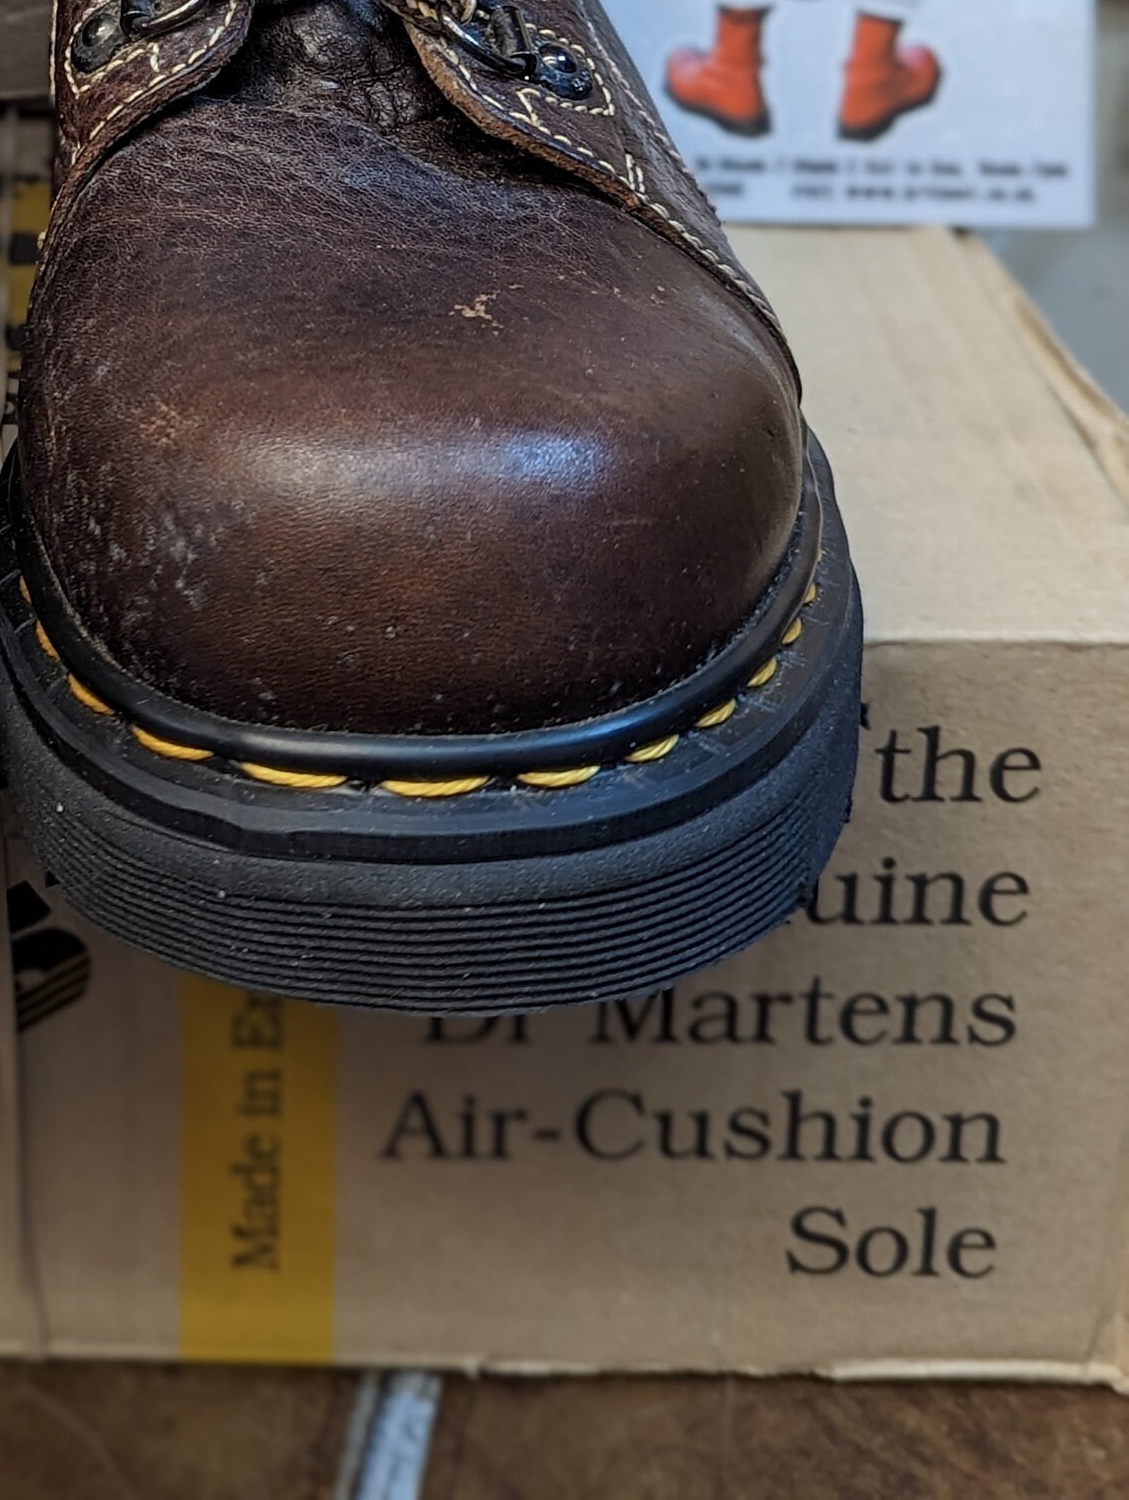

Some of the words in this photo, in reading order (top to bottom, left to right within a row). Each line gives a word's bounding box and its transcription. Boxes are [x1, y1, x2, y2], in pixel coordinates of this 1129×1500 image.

[874, 725, 1042, 804] the
[786, 856, 1031, 928] uine
[380, 1088, 1007, 1165] Air-Cushion
[786, 1204, 998, 1280] Sole
